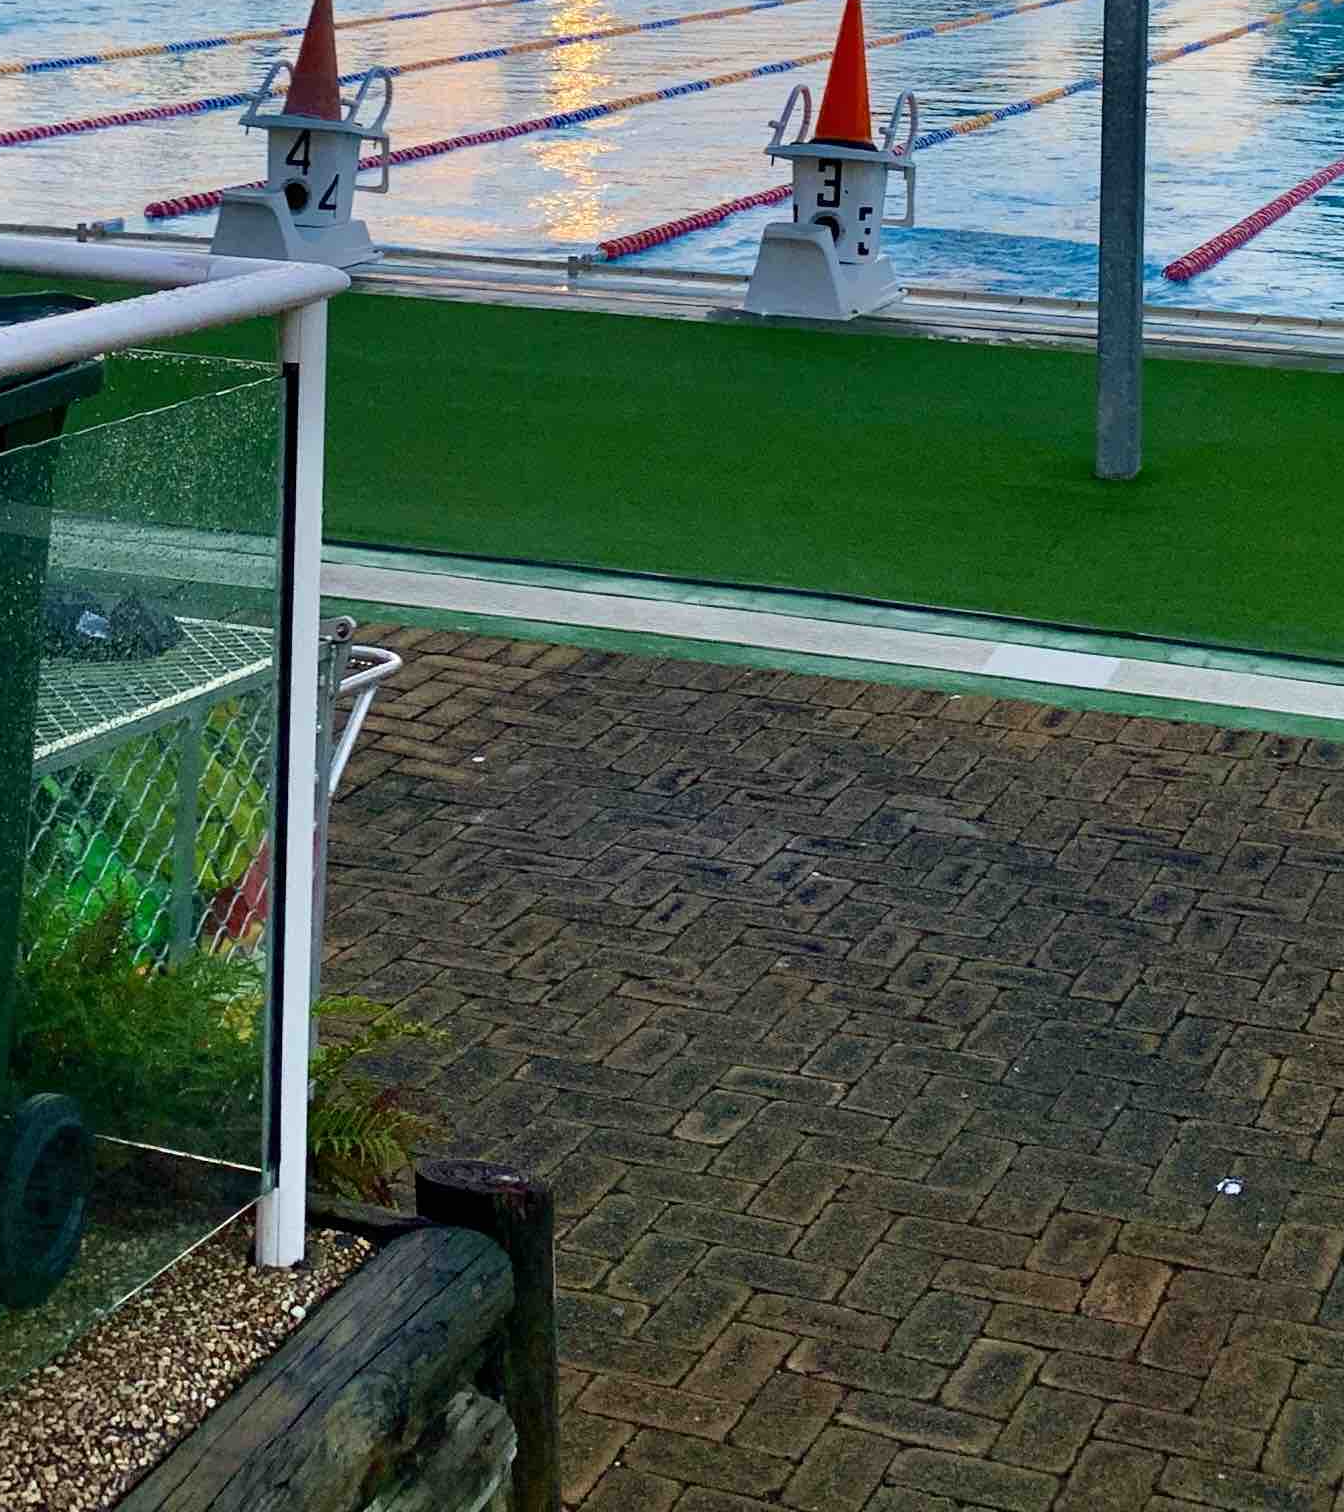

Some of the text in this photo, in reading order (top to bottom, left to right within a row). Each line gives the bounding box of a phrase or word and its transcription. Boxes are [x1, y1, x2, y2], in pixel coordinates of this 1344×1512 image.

[286, 129, 311, 176] 4
[318, 173, 340, 219] 4
[816, 158, 842, 208] 3
